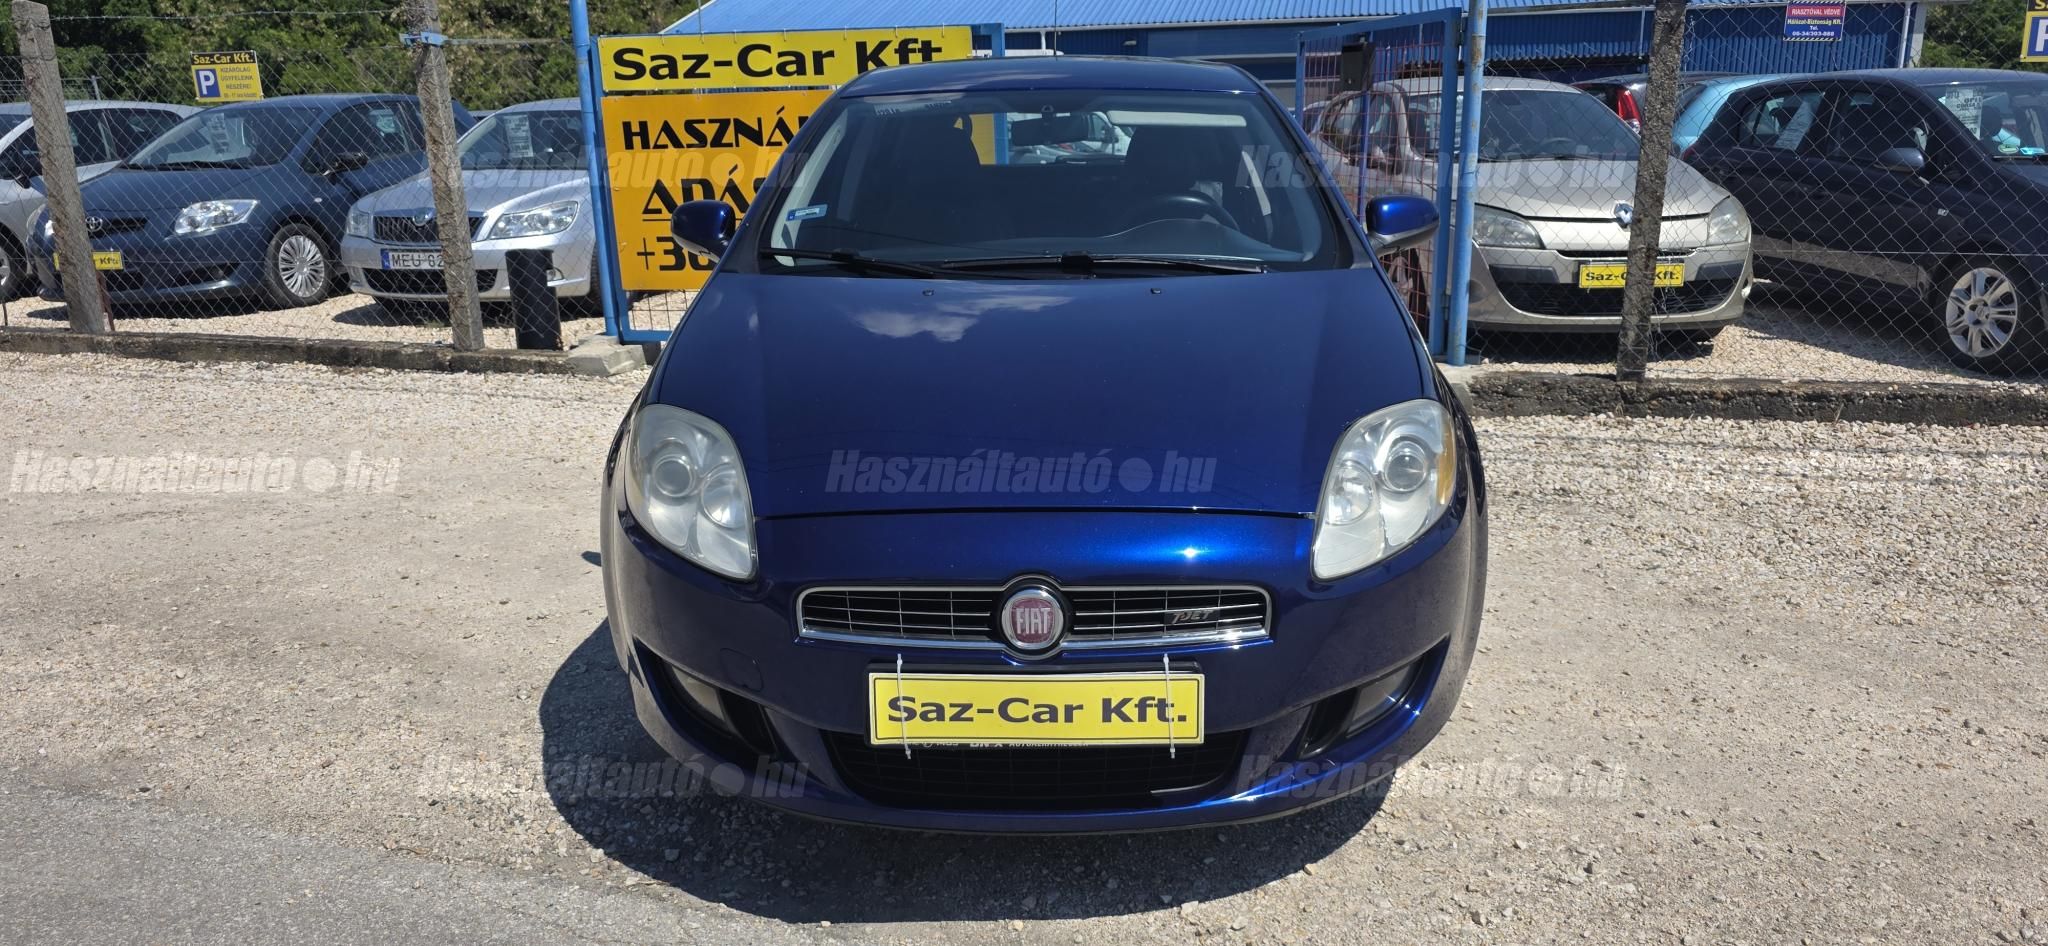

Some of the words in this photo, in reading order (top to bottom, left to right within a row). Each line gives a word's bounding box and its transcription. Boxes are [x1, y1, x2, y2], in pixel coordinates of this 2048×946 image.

[193, 54, 231, 64] Saz-Car
[233, 53, 253, 63] Kft.
[612, 43, 836, 82] Saz-Car
[198, 70, 215, 94] P
[642, 163, 768, 215] ADÁ
[1015, 607, 1050, 634] FIAT
[888, 695, 1083, 724] Saz-Car
[1101, 695, 1187, 723] Kft.
